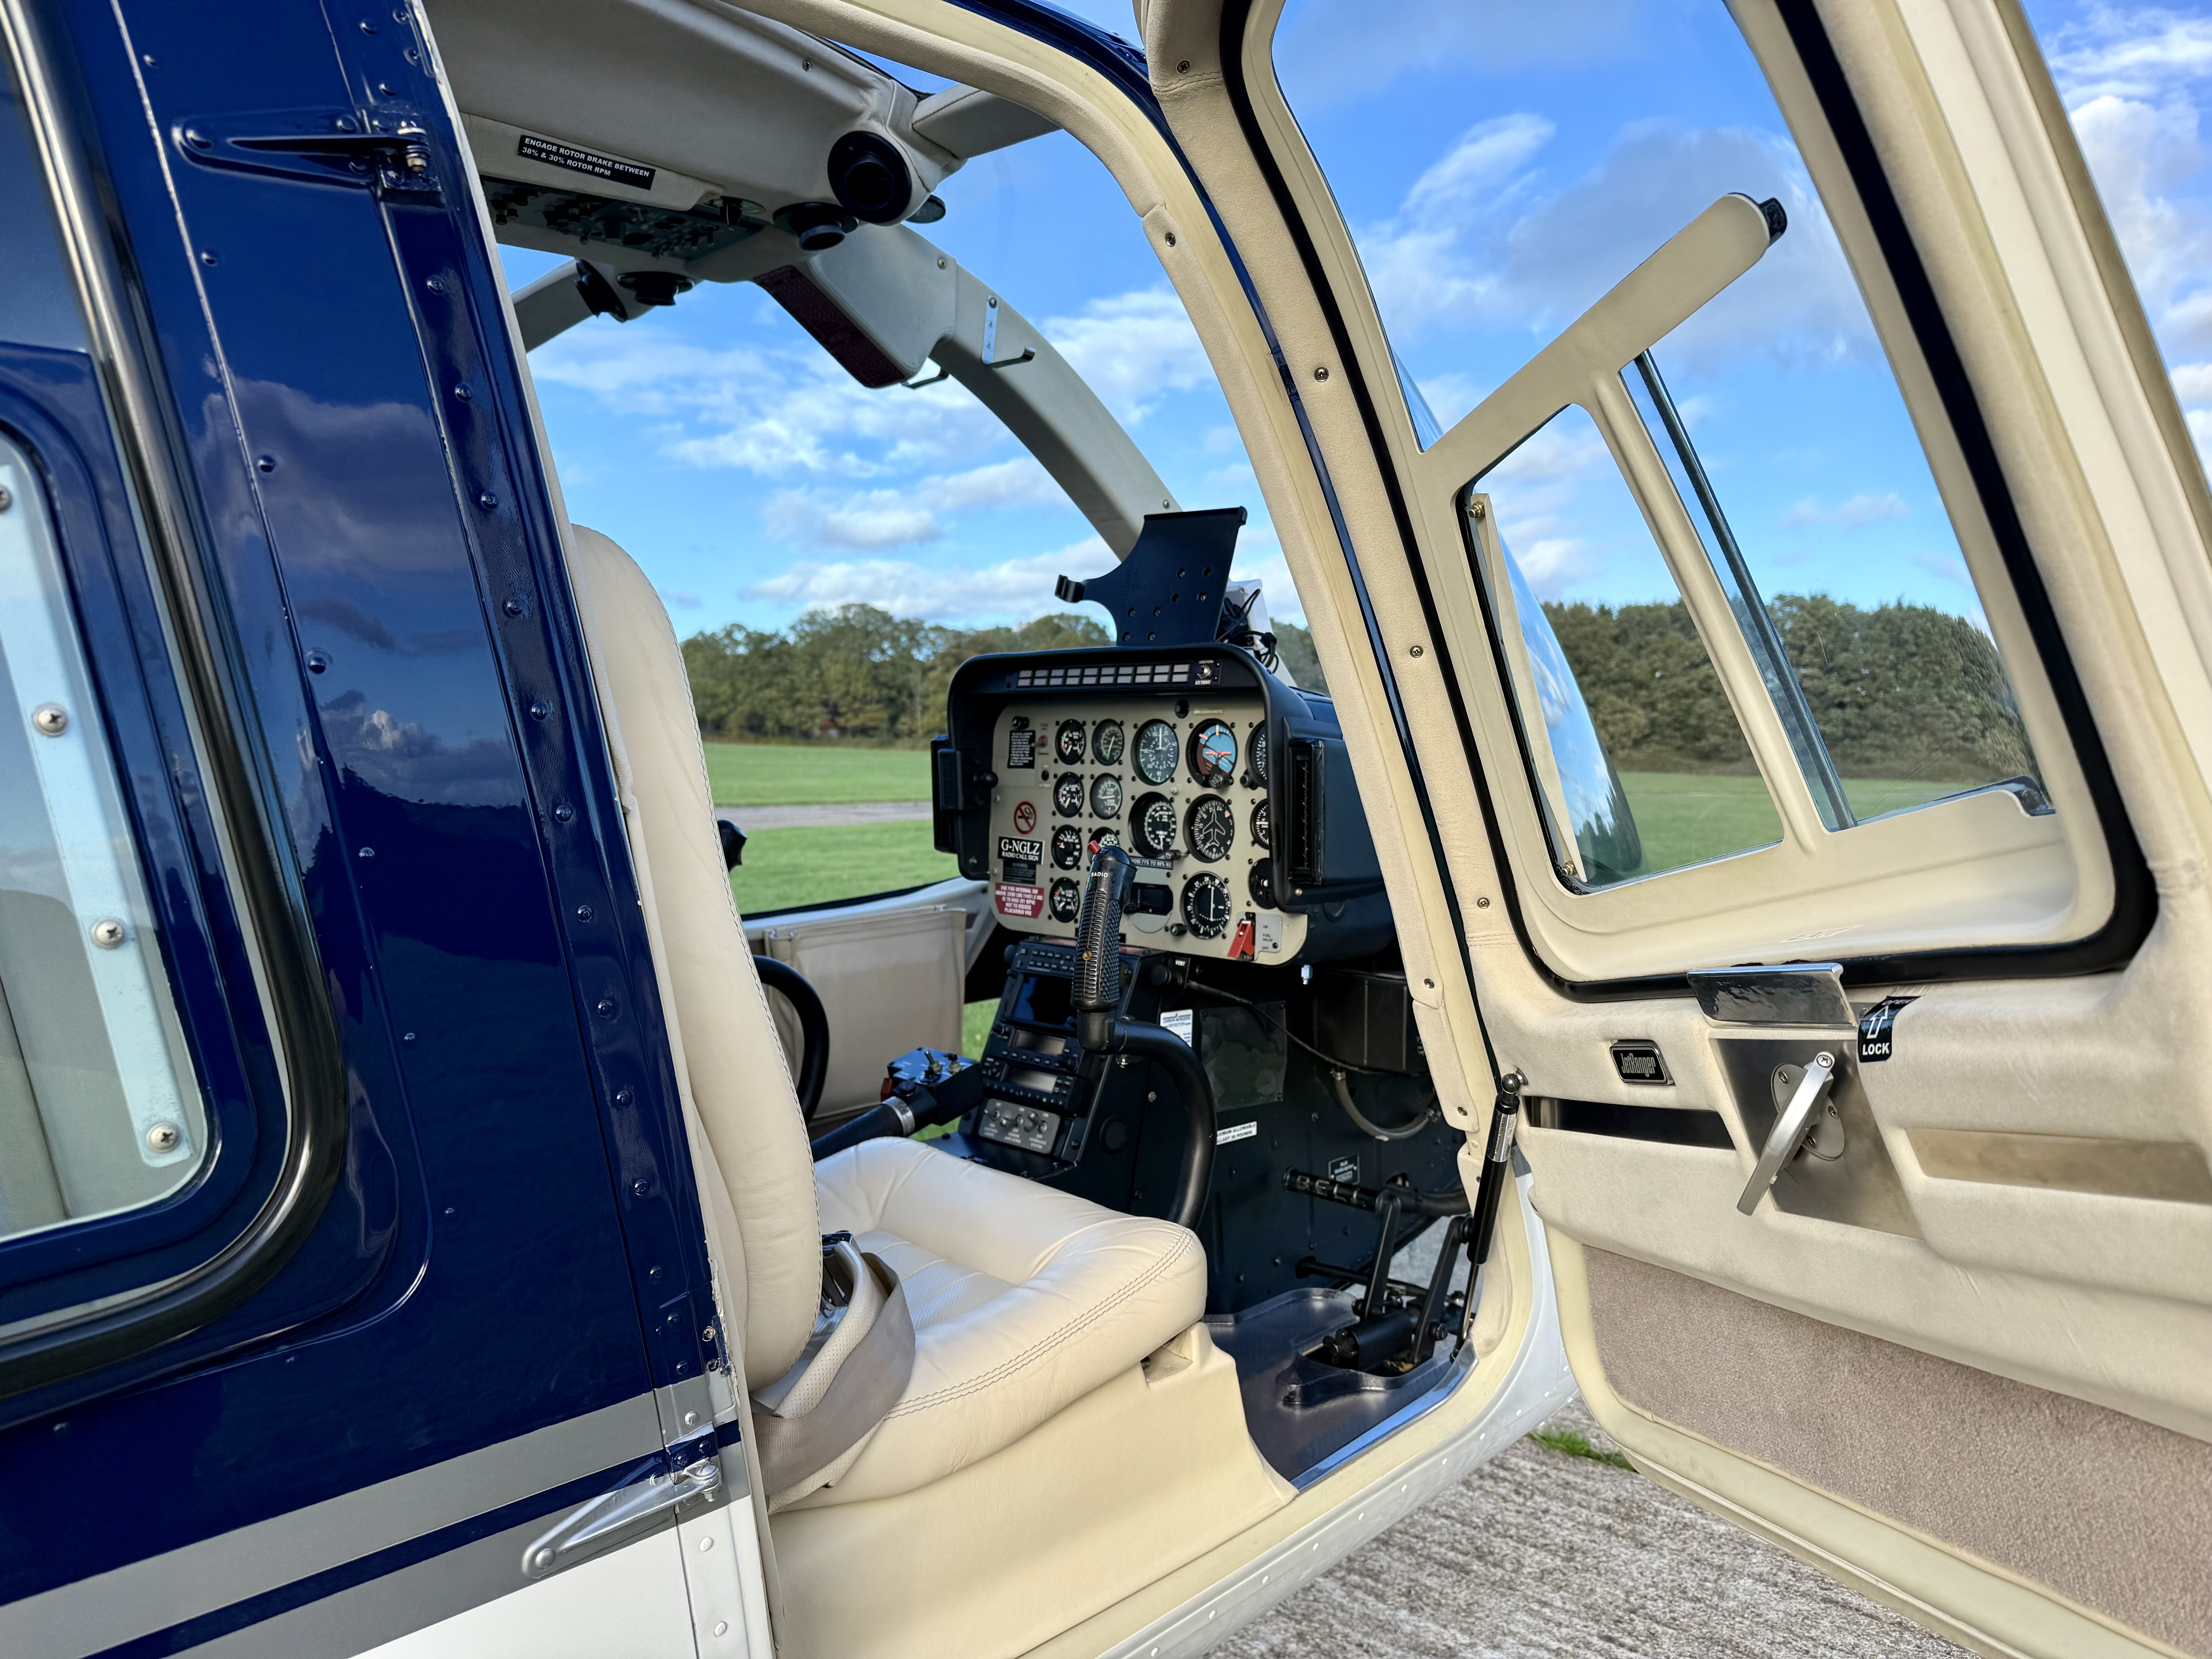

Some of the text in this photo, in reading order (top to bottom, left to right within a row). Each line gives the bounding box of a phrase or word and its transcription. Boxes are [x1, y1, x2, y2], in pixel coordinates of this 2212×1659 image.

[522, 147, 538, 156] 38%
[549, 155, 565, 164] 30%
[567, 159, 592, 171] ROTOR
[594, 167, 611, 176] RPM
[525, 138, 649, 177] ENGAGE ROTOR BRAKE BETWEEN
[1001, 839, 1040, 855] G-NGLZ
[1862, 1042, 1890, 1056] LOCK
[1621, 1053, 1656, 1077] JetRanger
